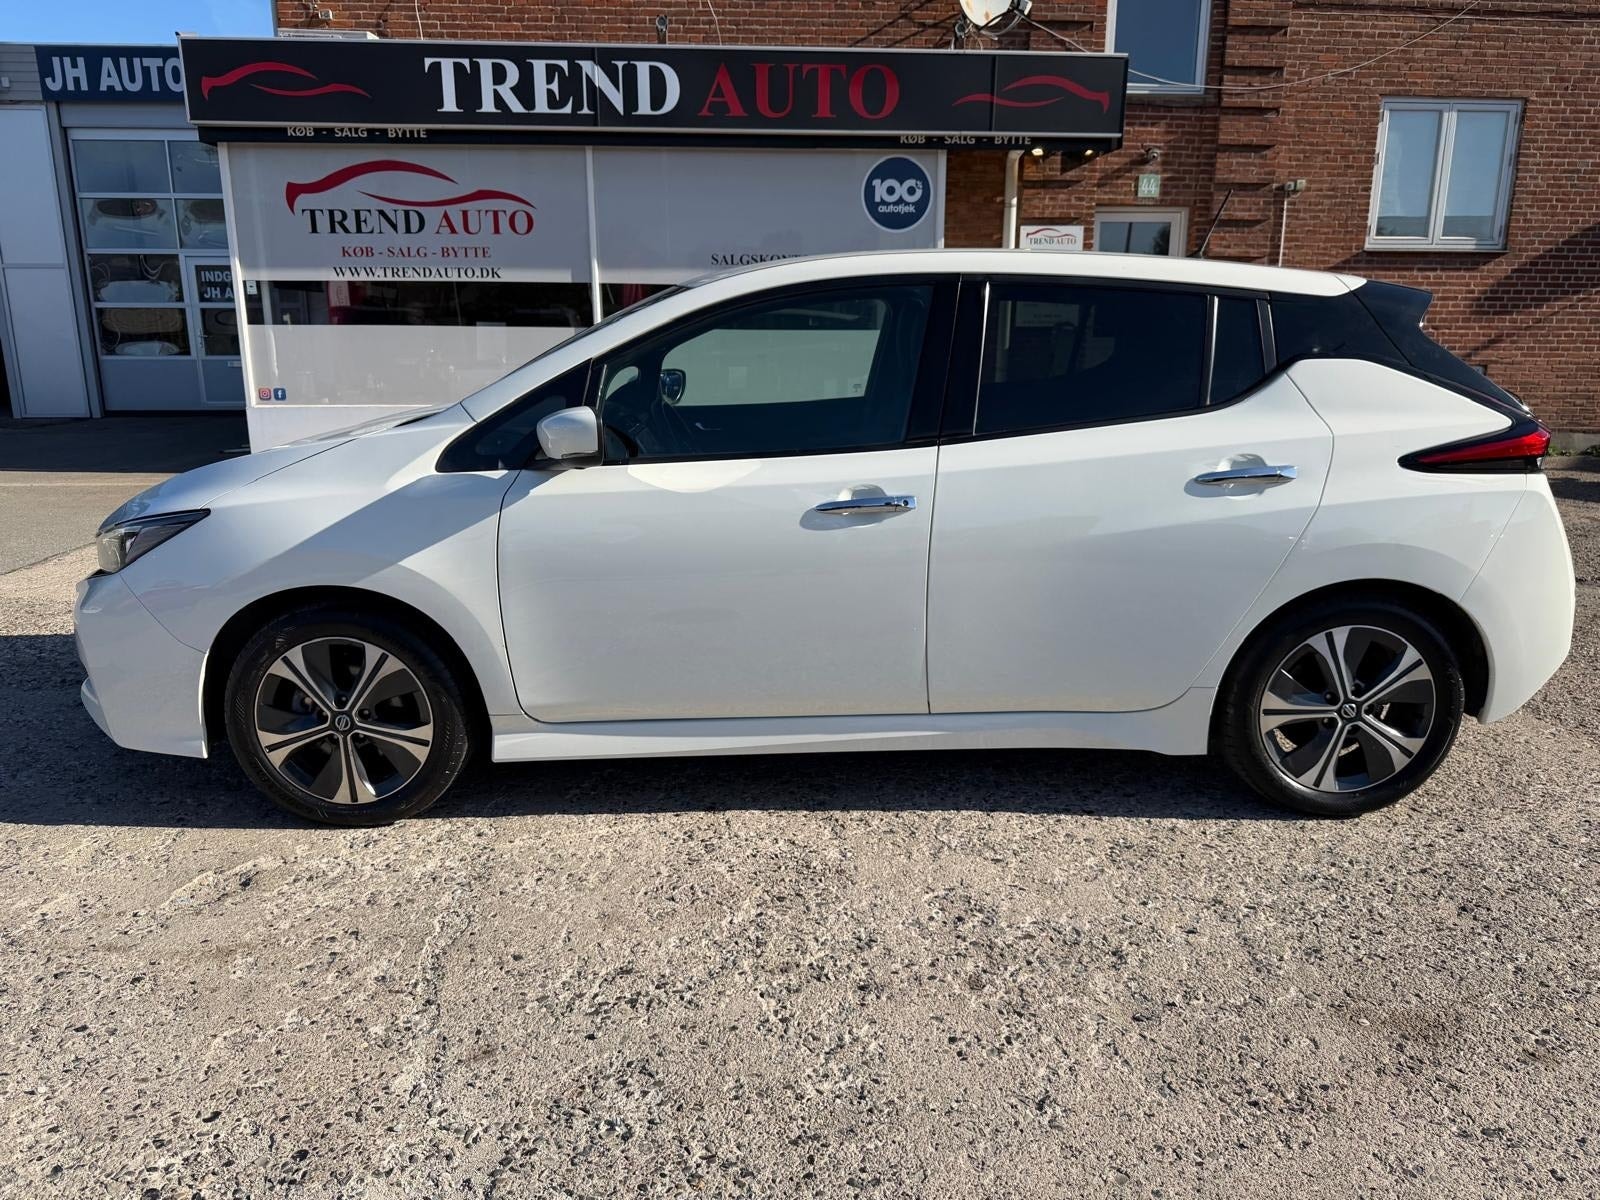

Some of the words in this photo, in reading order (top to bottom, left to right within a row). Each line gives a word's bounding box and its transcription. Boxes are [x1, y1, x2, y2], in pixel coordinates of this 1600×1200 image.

[44, 56, 88, 92] JH
[99, 57, 185, 93] AUTO
[424, 57, 681, 117] TREND
[697, 62, 900, 120] AUTO
[287, 126, 315, 137] KØB
[334, 127, 368, 138] SALG
[387, 127, 428, 139] BYTTE
[944, 136, 976, 145] SALG
[994, 136, 1032, 146] BYTTE
[1141, 177, 1156, 194] 44
[301, 208, 427, 235] TREND
[435, 209, 535, 236] AUTO
[1029, 236, 1054, 246] TREND
[1055, 236, 1077, 246] AUTO
[341, 246, 375, 258] KØB
[386, 246, 428, 259] SALG
[441, 246, 492, 259] BYTTE
[201, 270, 233, 282] INDG
[332, 266, 502, 280] WWW.TRENDAUTO.DK
[203, 287, 220, 299] JH
